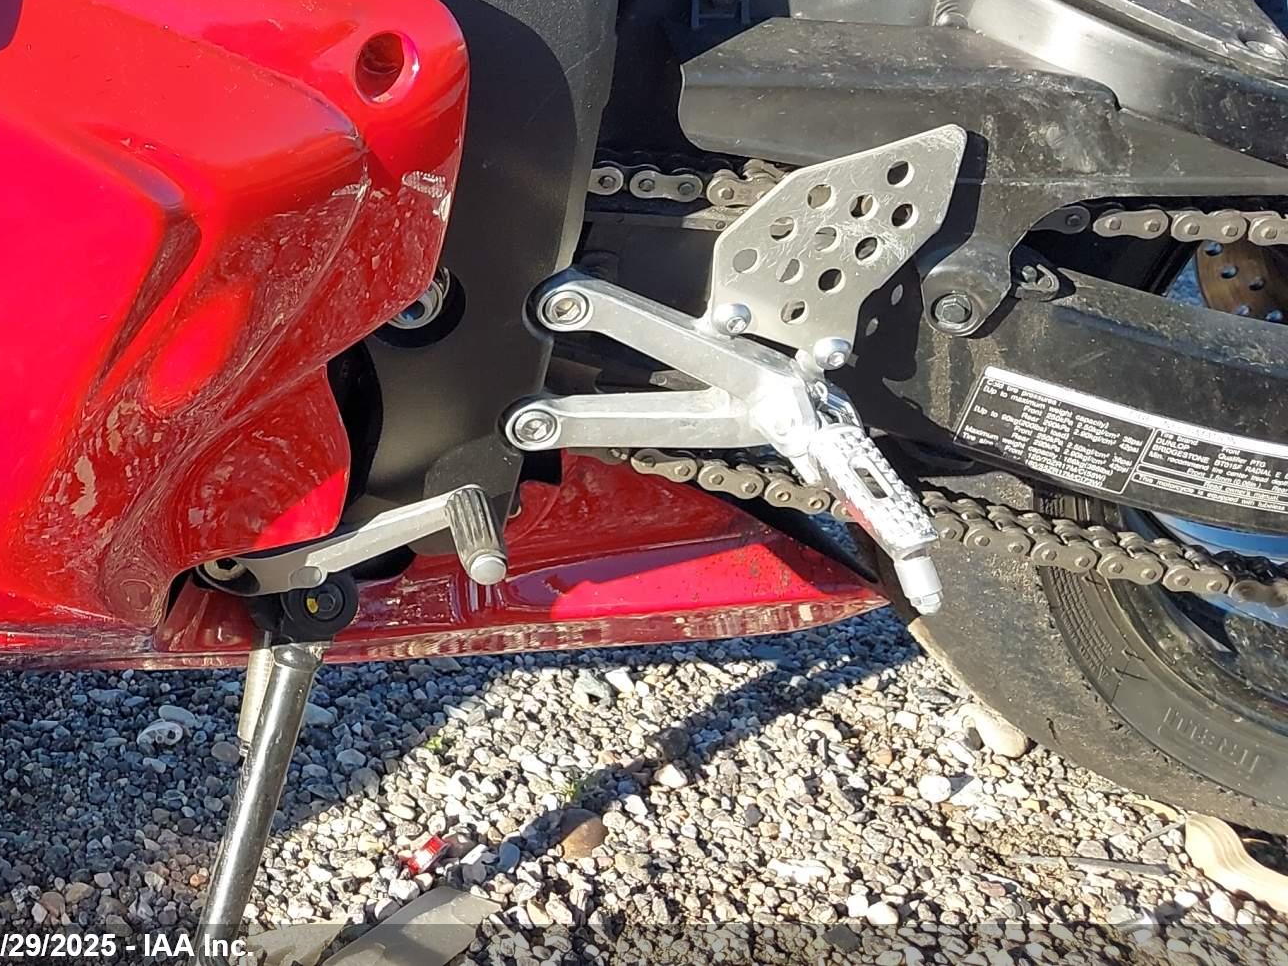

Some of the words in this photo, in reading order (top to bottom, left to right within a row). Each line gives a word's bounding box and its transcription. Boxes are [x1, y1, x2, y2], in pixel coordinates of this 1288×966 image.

[1010, 395, 1045, 408] maximum
[1049, 406, 1072, 417] weight
[1023, 405, 1042, 415] Front
[1021, 412, 1039, 421] Rear
[964, 425, 998, 440] Maximum
[1002, 438, 1025, 448] weight
[1011, 432, 1029, 441] Rear
[1014, 425, 1032, 435] Front
[963, 431, 975, 440] Tire
[1004, 445, 1023, 455] Front
[1155, 437, 1189, 449] DUNLOP
[1176, 436, 1198, 445] brand
[1221, 446, 1239, 454] Front
[1151, 444, 1209, 463] BRIDGESTONE
[1244, 466, 1270, 476] RADIAL
[1167, 456, 1209, 470] recommend
[1226, 470, 1247, 478] center
[1186, 468, 1205, 476] Front
[1155, 479, 1193, 494] motorcycle
